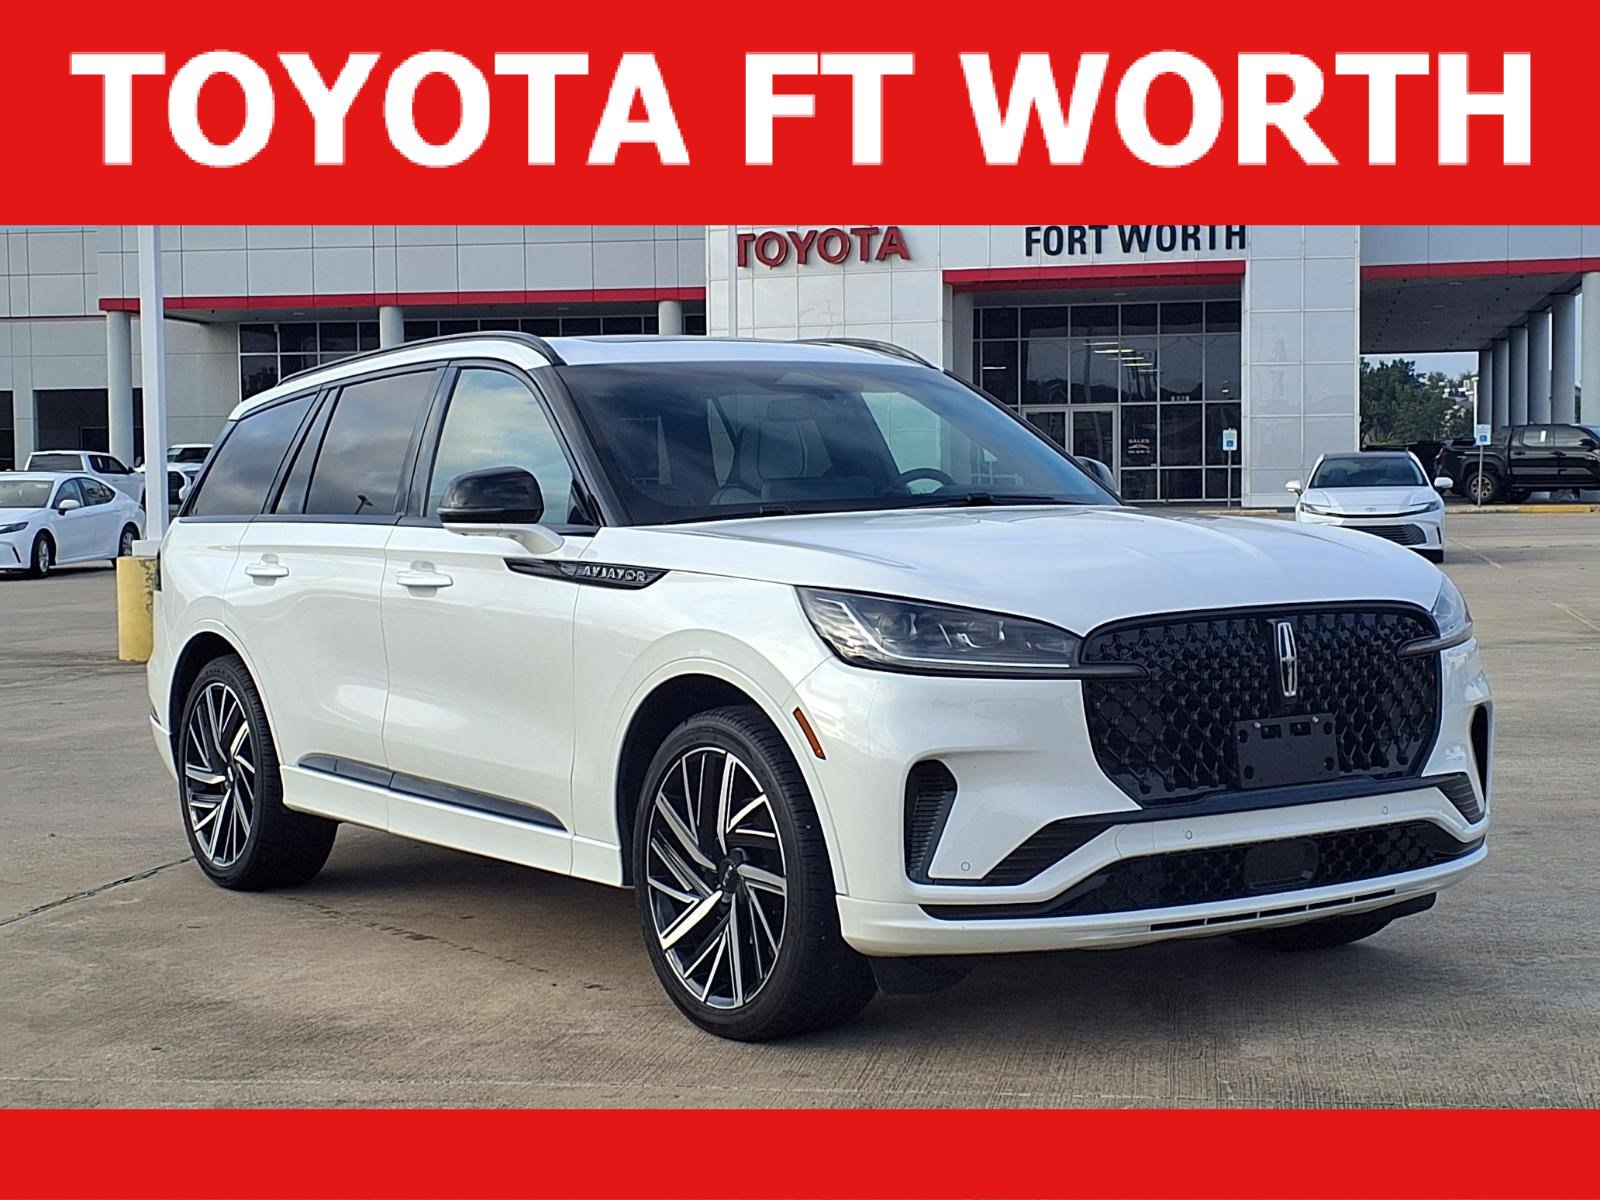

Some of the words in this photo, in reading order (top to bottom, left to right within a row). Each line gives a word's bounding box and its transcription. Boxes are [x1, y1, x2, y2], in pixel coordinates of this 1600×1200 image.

[737, 226, 910, 268] TOYOTA
[1025, 225, 1108, 256] FORT
[1117, 225, 1246, 253] WORTH
[582, 564, 646, 582] AVIATOR
